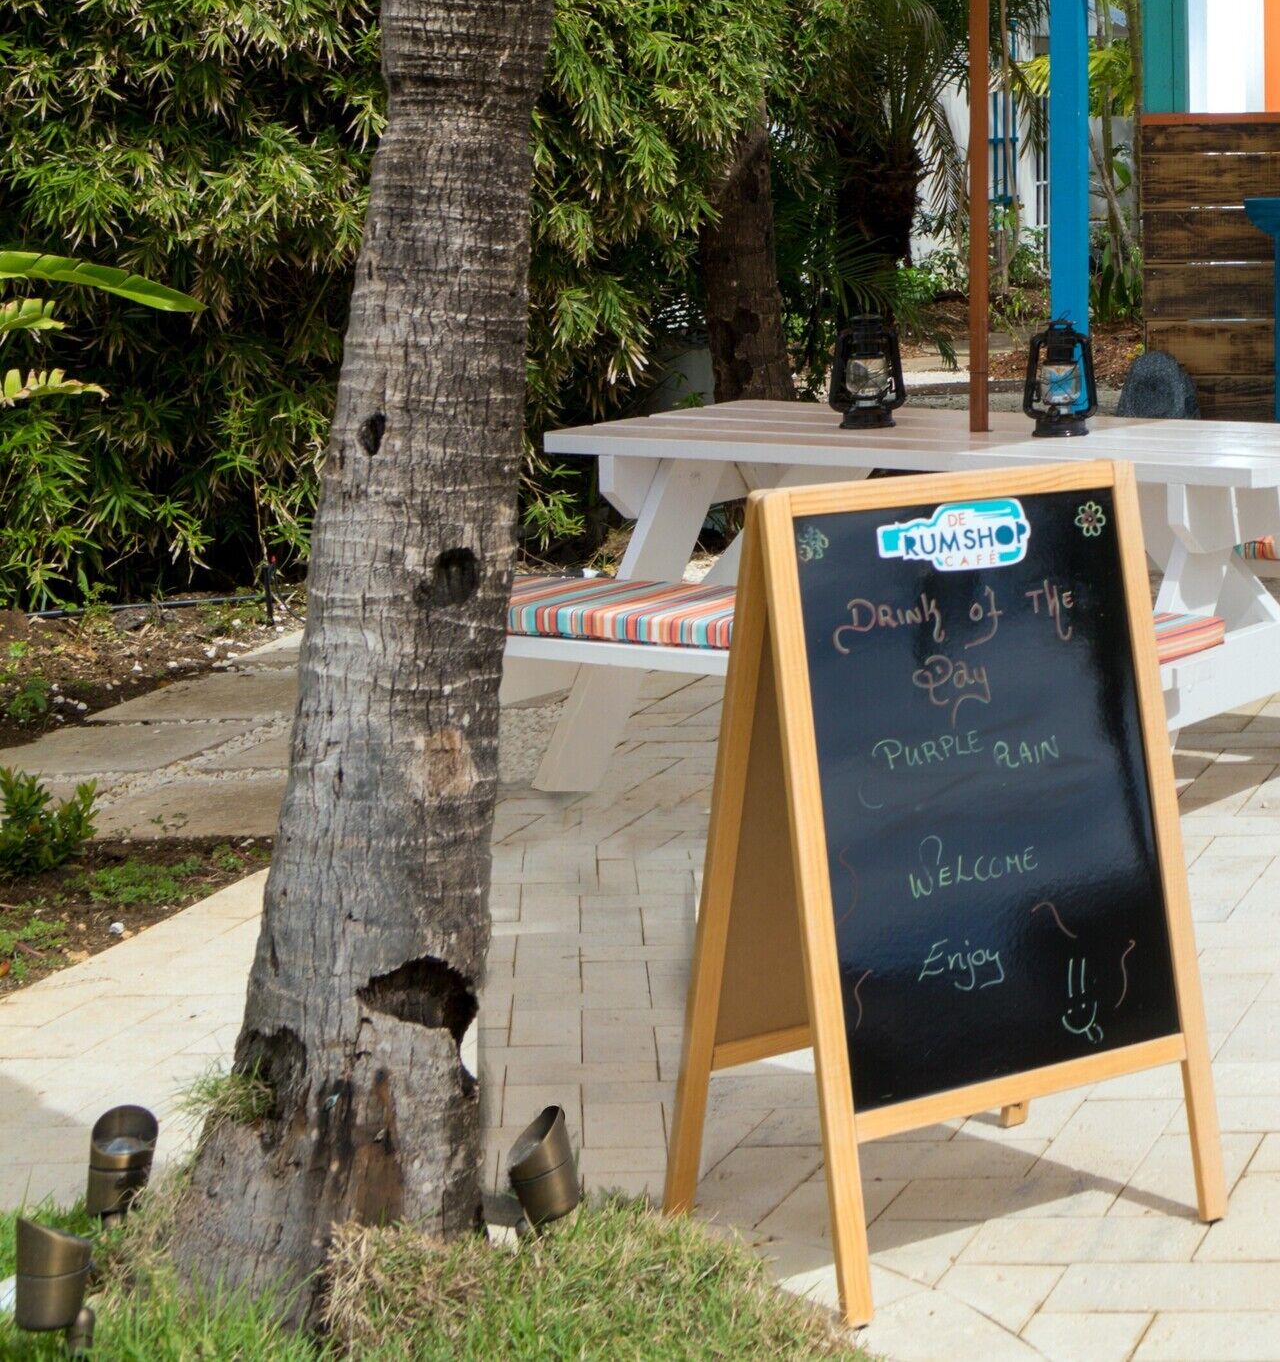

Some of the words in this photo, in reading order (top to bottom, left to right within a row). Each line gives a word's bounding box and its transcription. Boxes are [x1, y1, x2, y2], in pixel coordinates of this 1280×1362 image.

[947, 512, 967, 528] DE
[944, 548, 997, 568] CAFÉ
[871, 729, 984, 771] PURPLE
[993, 734, 1060, 769] RAIN
[908, 834, 1040, 899] WELCOME
[918, 939, 1005, 991] Enjoy
